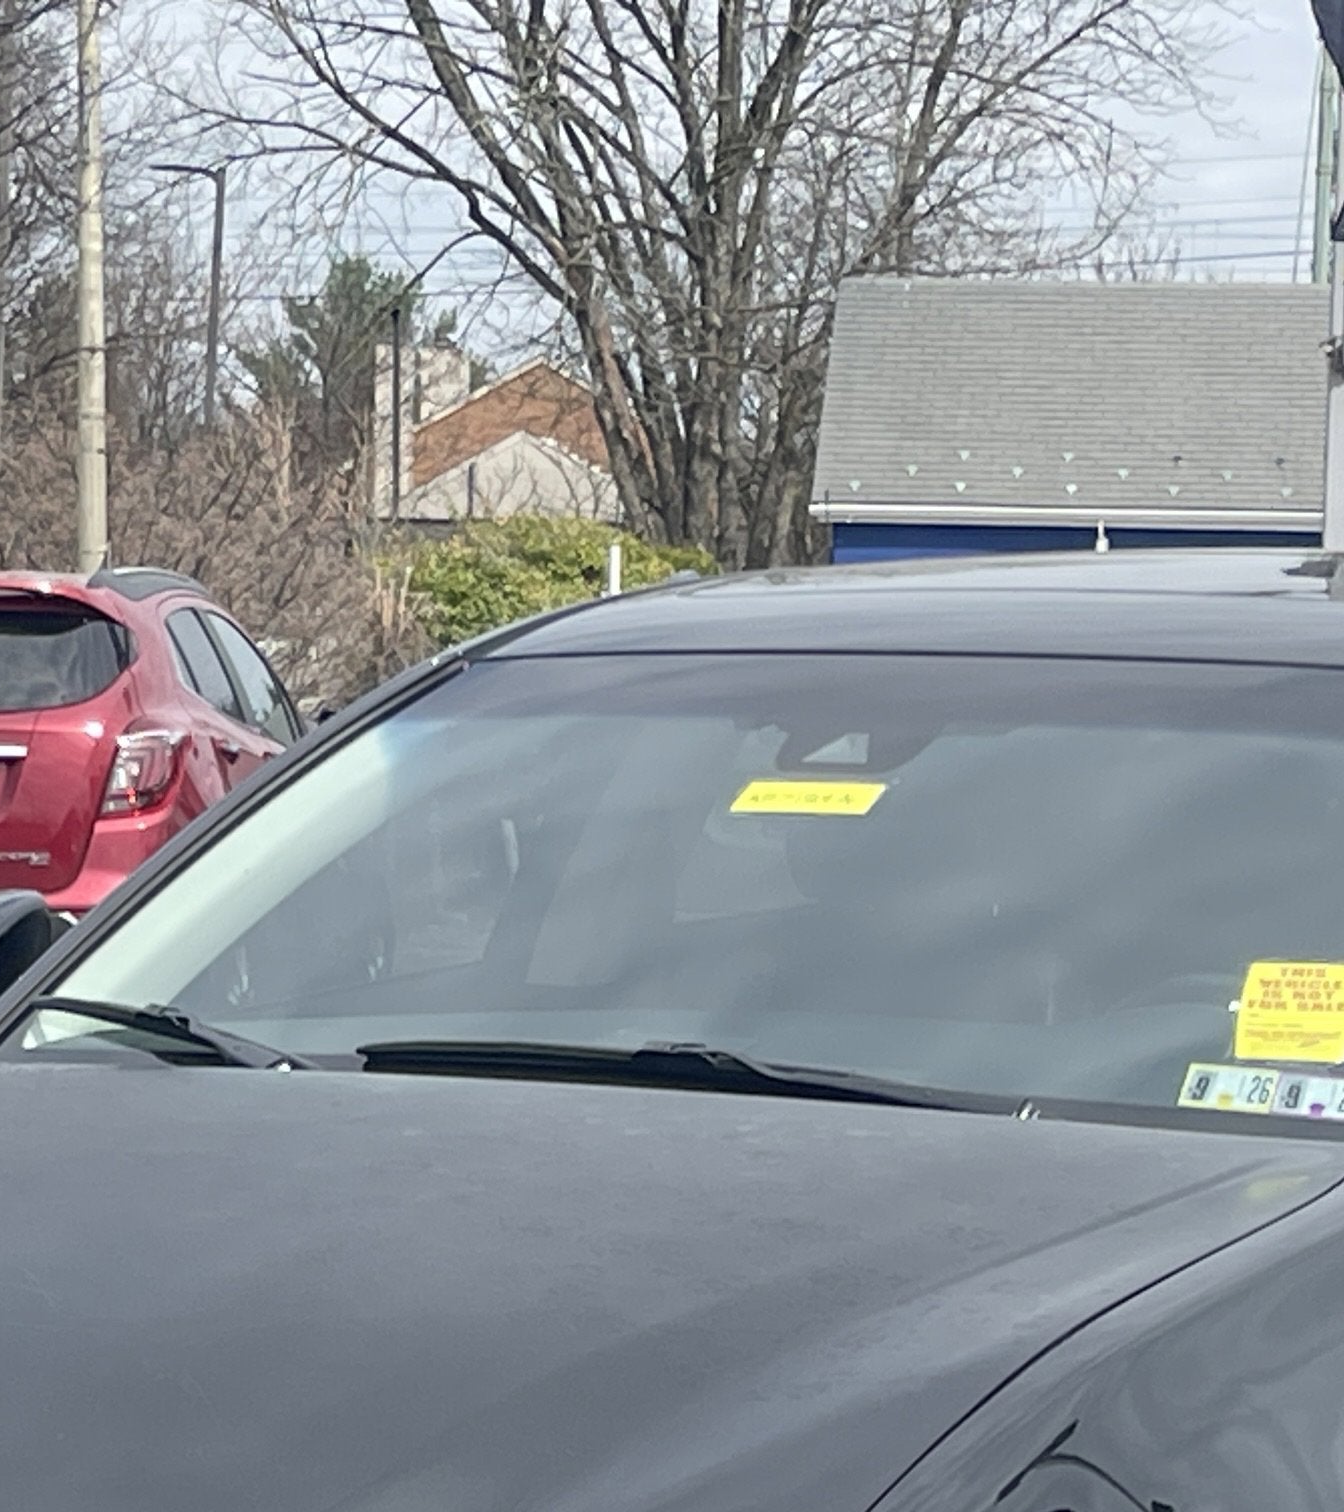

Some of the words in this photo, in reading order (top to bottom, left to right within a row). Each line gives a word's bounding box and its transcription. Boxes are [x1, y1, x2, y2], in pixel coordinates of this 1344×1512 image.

[1192, 1076, 1211, 1101] 9
[1246, 1075, 1274, 1104] 26
[1285, 1084, 1302, 1109] 9
